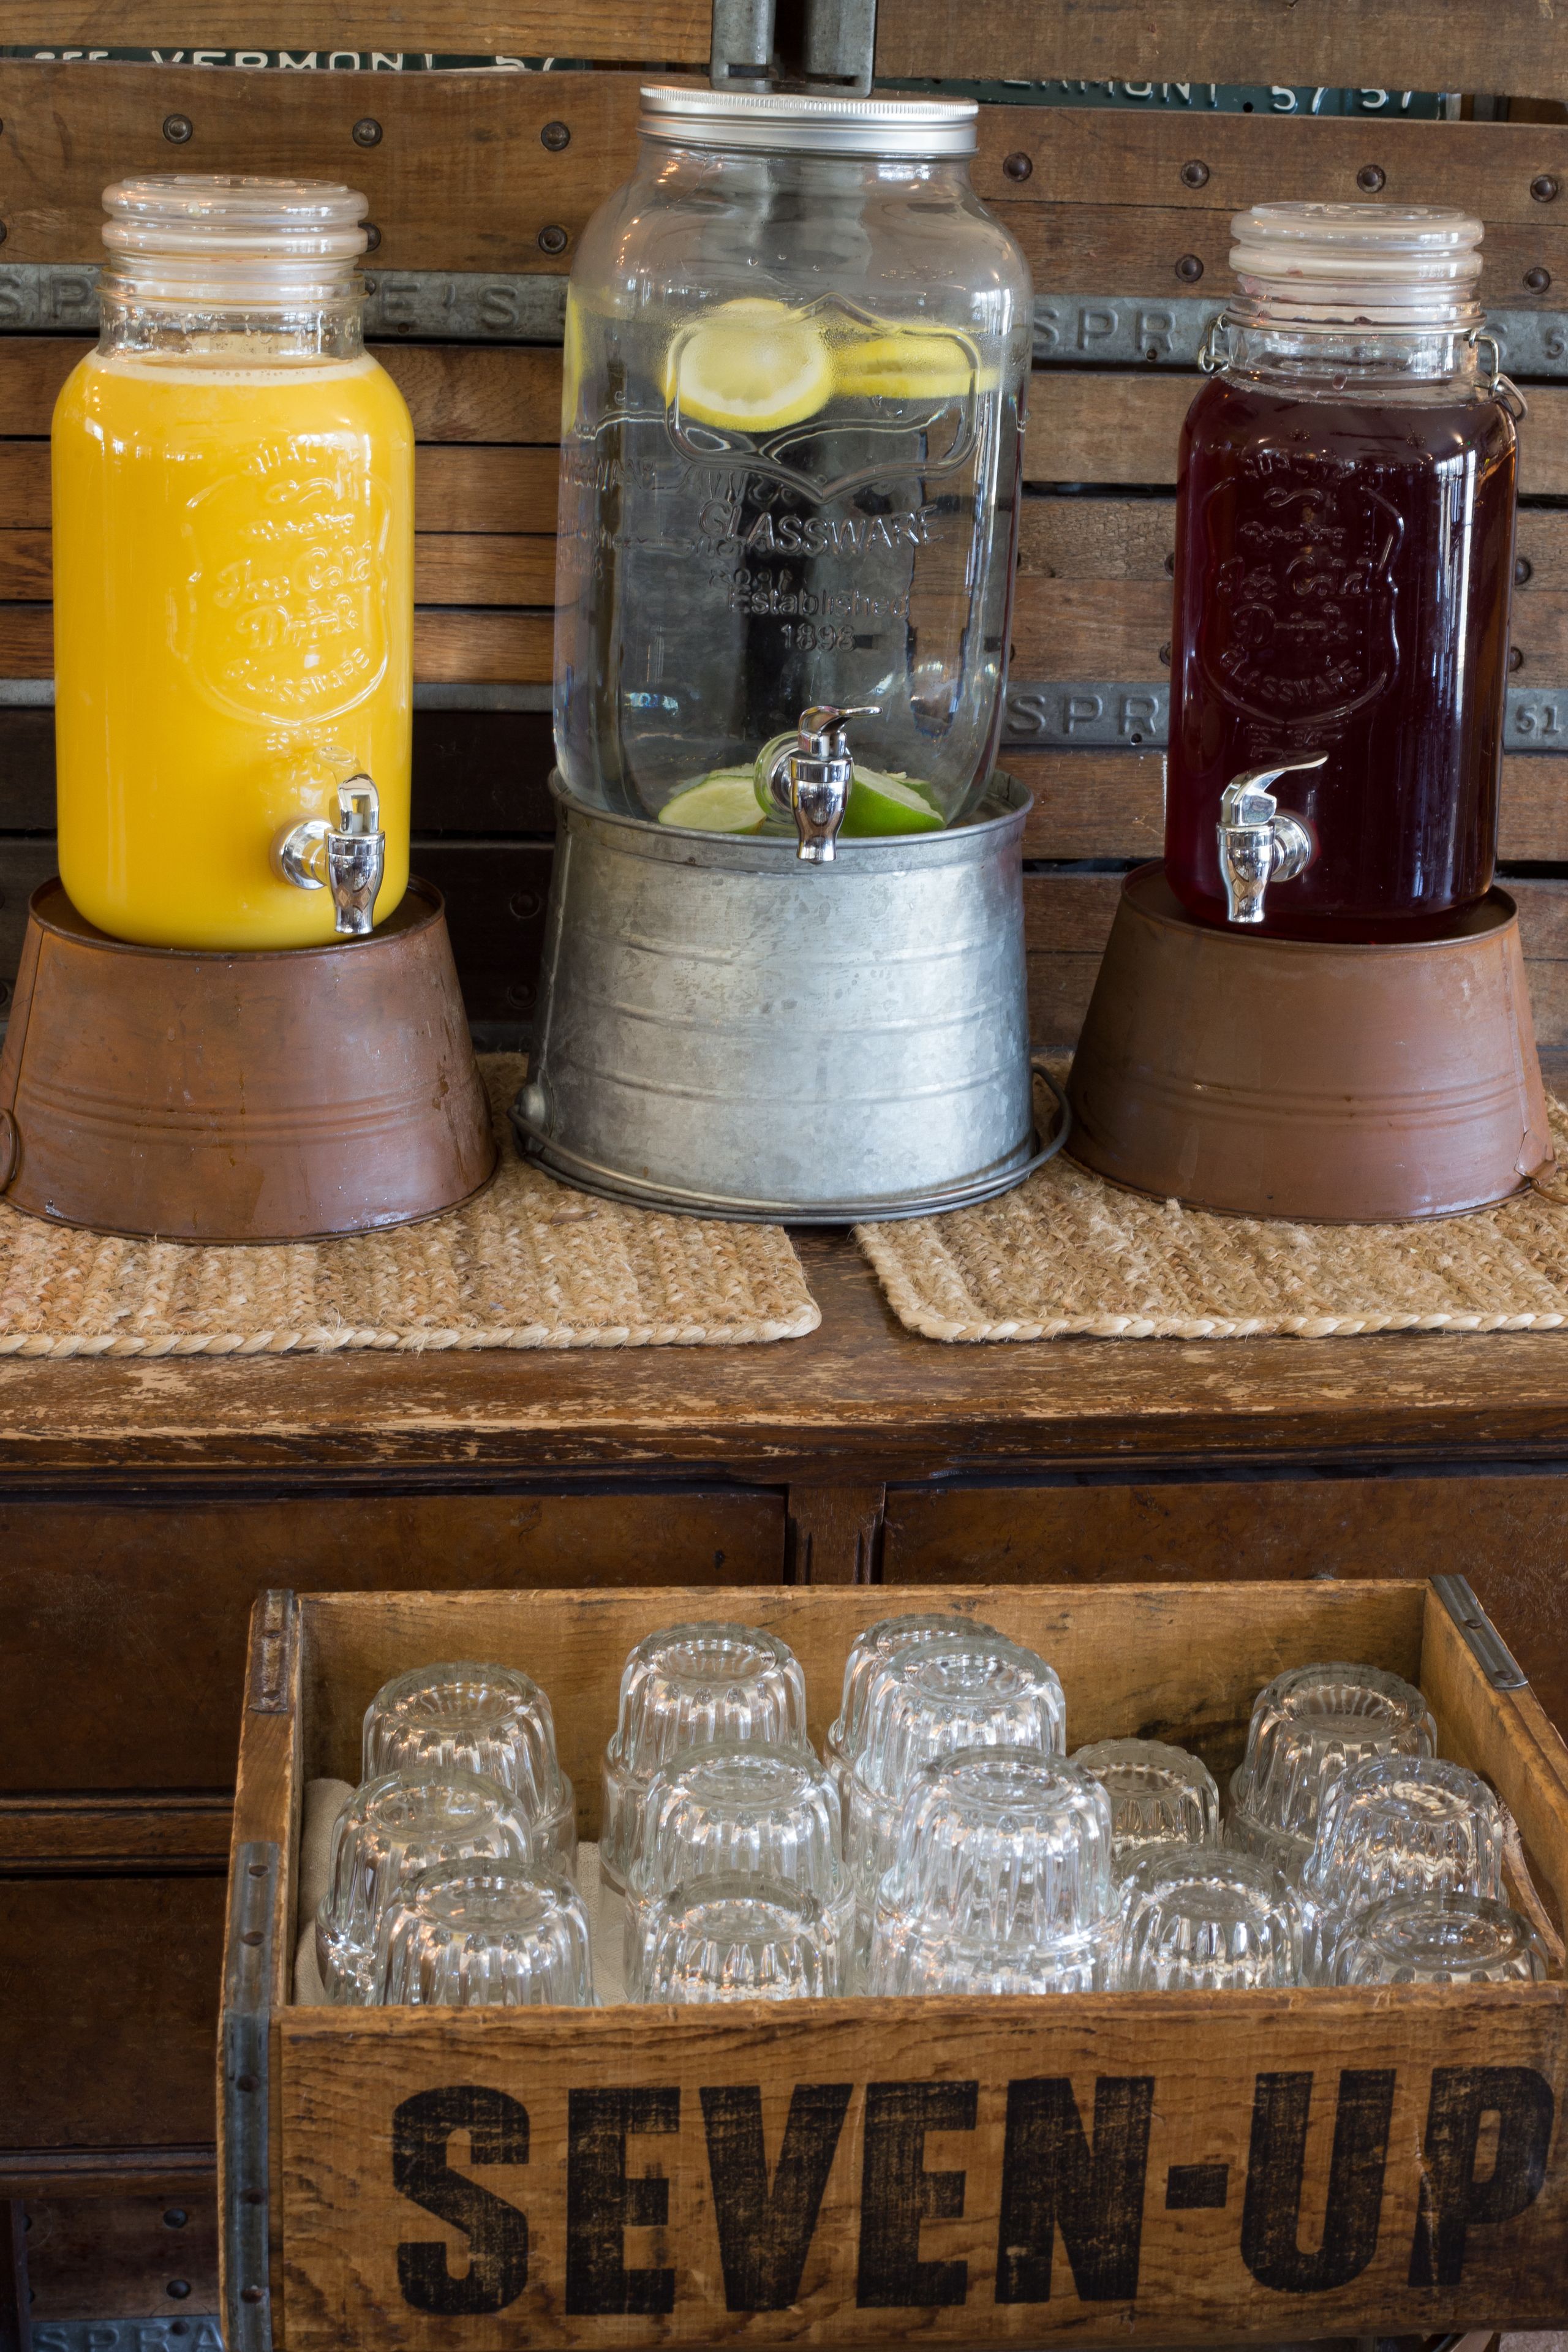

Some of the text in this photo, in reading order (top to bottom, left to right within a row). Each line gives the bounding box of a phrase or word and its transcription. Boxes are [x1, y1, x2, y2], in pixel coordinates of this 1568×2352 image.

[699, 504, 944, 556] GLASSWARE
[727, 588, 910, 619] Established
[780, 624, 856, 653] 1898
[1006, 694, 1159, 735] SPR
[1515, 704, 1561, 735] 51
[393, 2066, 1555, 2316] SEVEN-UP
